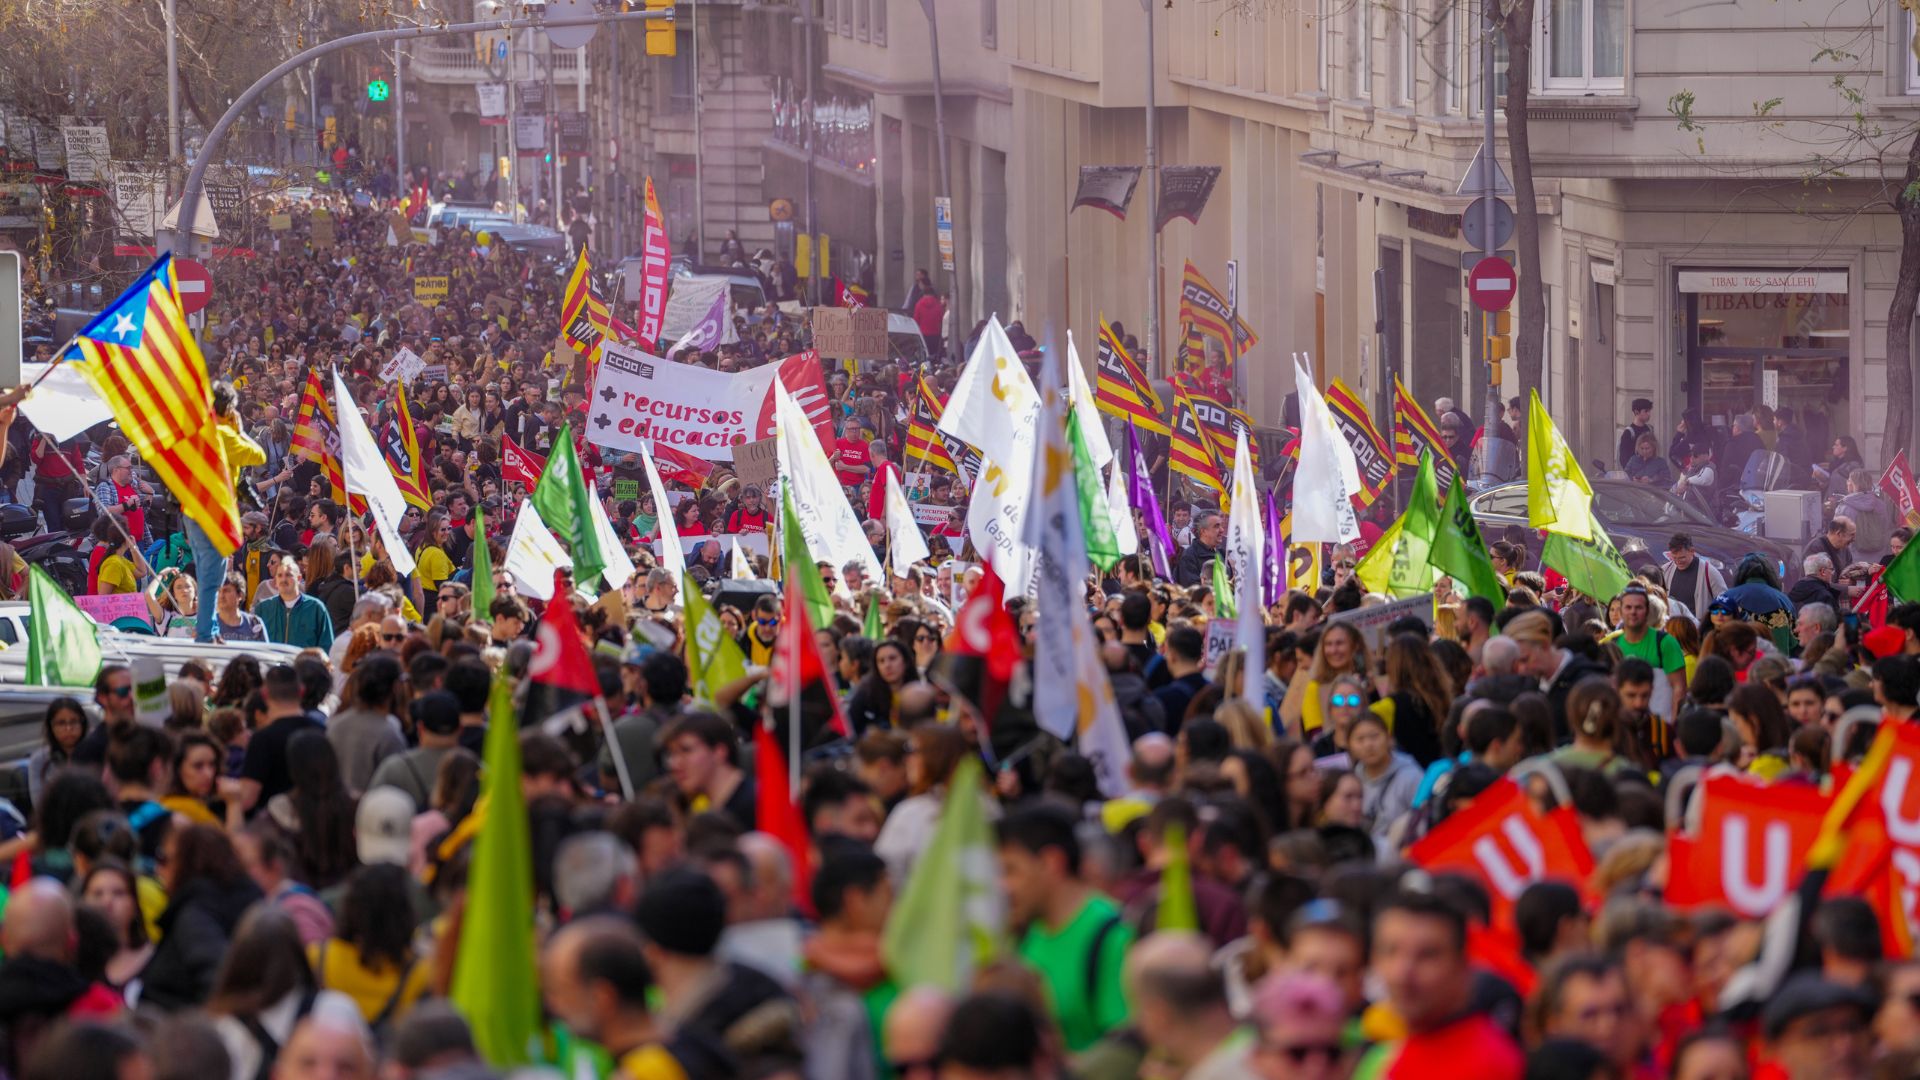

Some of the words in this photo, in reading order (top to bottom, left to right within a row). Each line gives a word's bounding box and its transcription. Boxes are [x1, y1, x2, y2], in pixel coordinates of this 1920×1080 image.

[1711, 277, 1738, 287] TIBAU
[1743, 277, 1761, 287] T&S
[1183, 285, 1233, 321] CCOO
[608, 353, 639, 373] CCOO
[623, 391, 743, 426] recursos
[617, 417, 747, 449] educació
[1721, 813, 1790, 914] U
